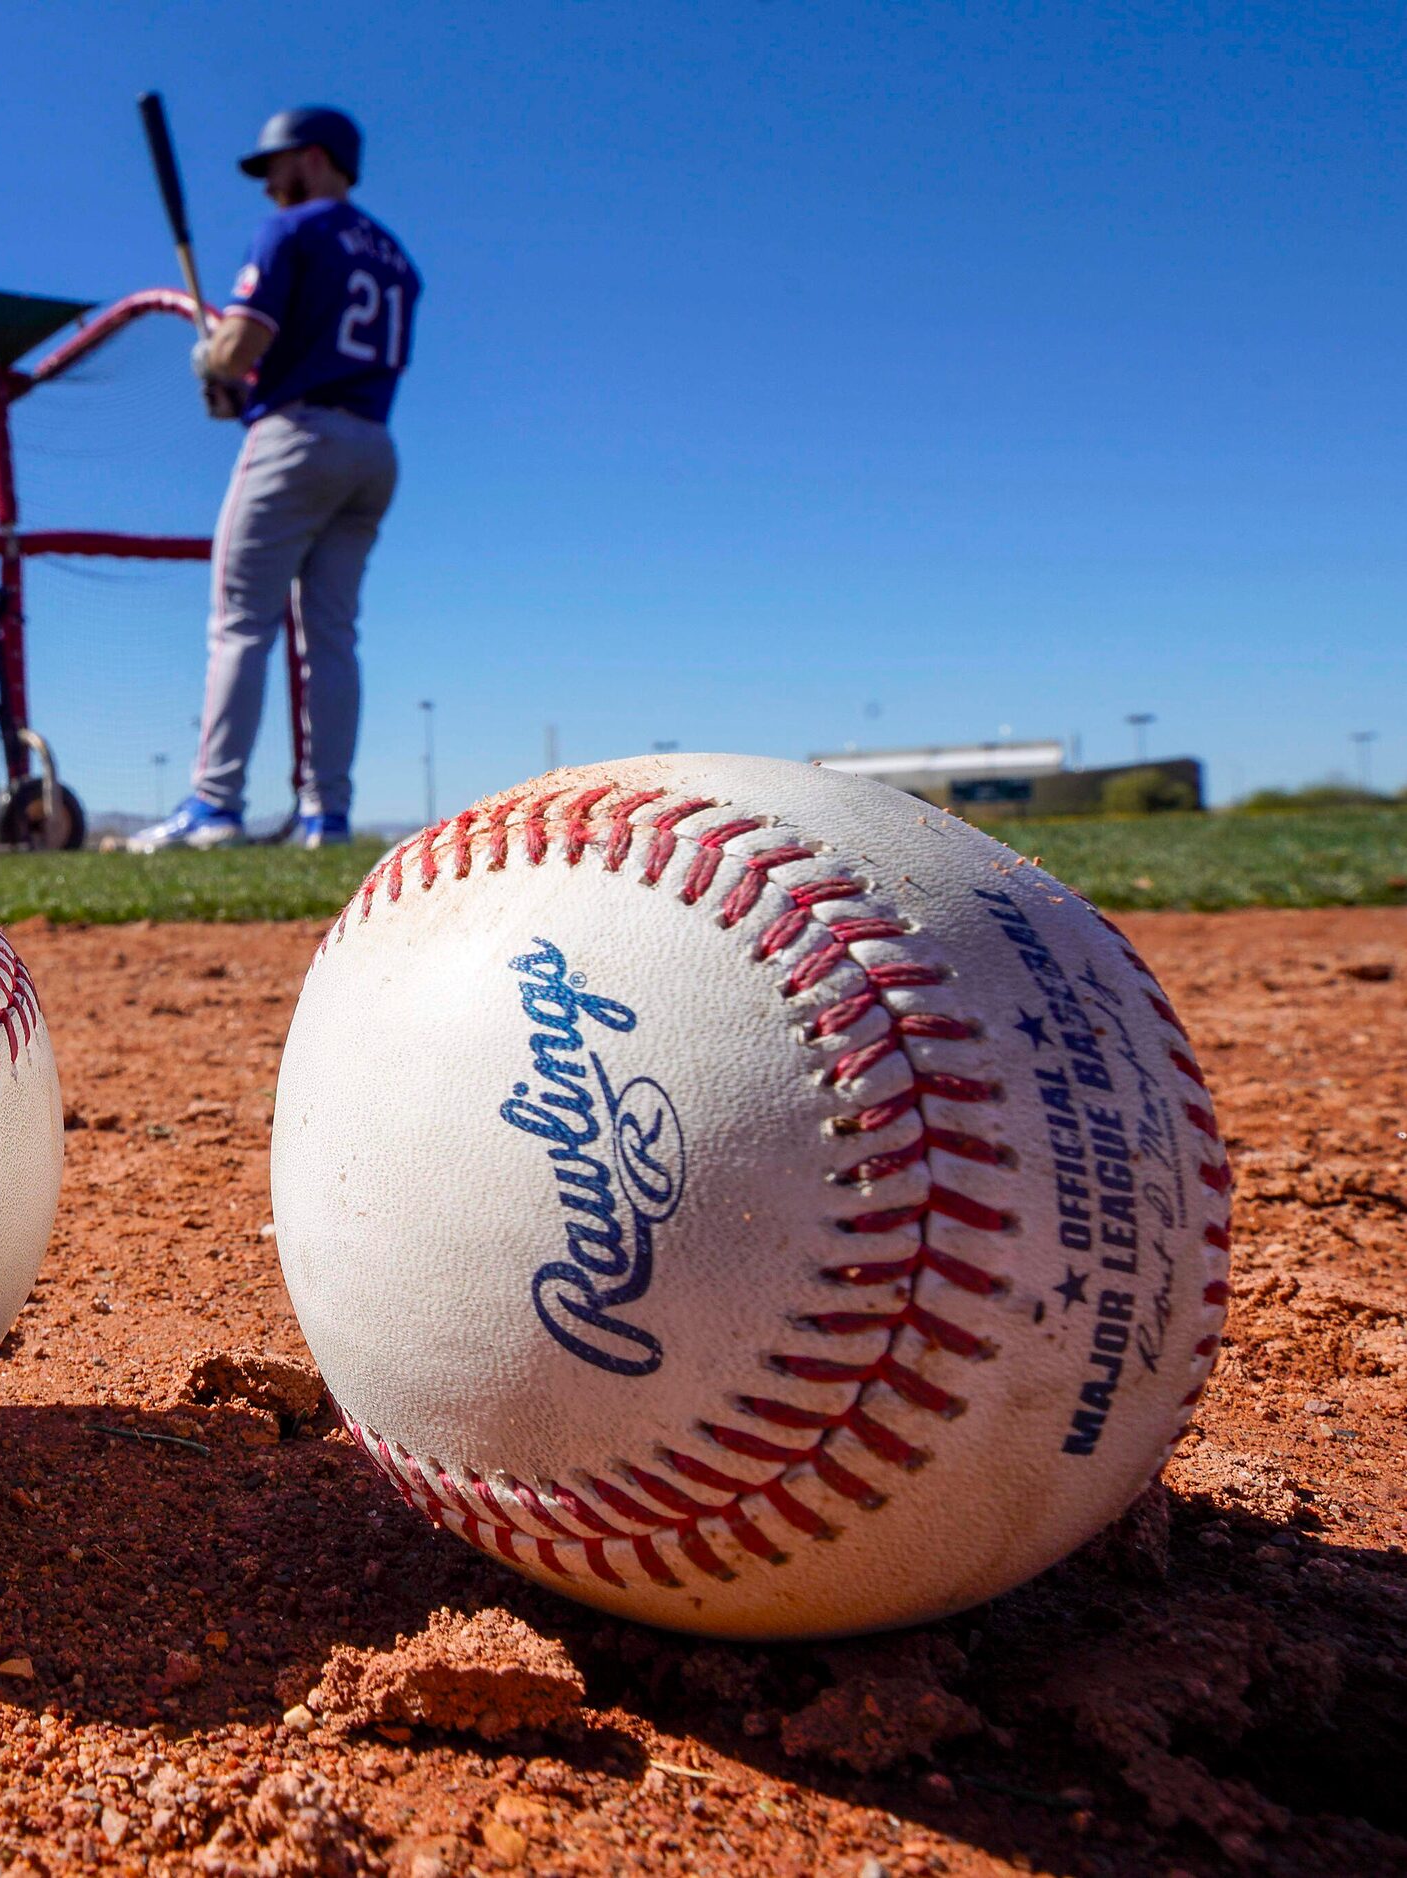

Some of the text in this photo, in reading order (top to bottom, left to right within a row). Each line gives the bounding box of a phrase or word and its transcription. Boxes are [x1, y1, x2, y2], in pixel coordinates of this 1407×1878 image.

[336, 269, 403, 369] 21
[500, 936, 664, 1377] Rawlings
[973, 888, 1138, 1456] MAJOR LEAGUE BASEBALL
[1034, 1065, 1092, 1251] OFFICIAL
